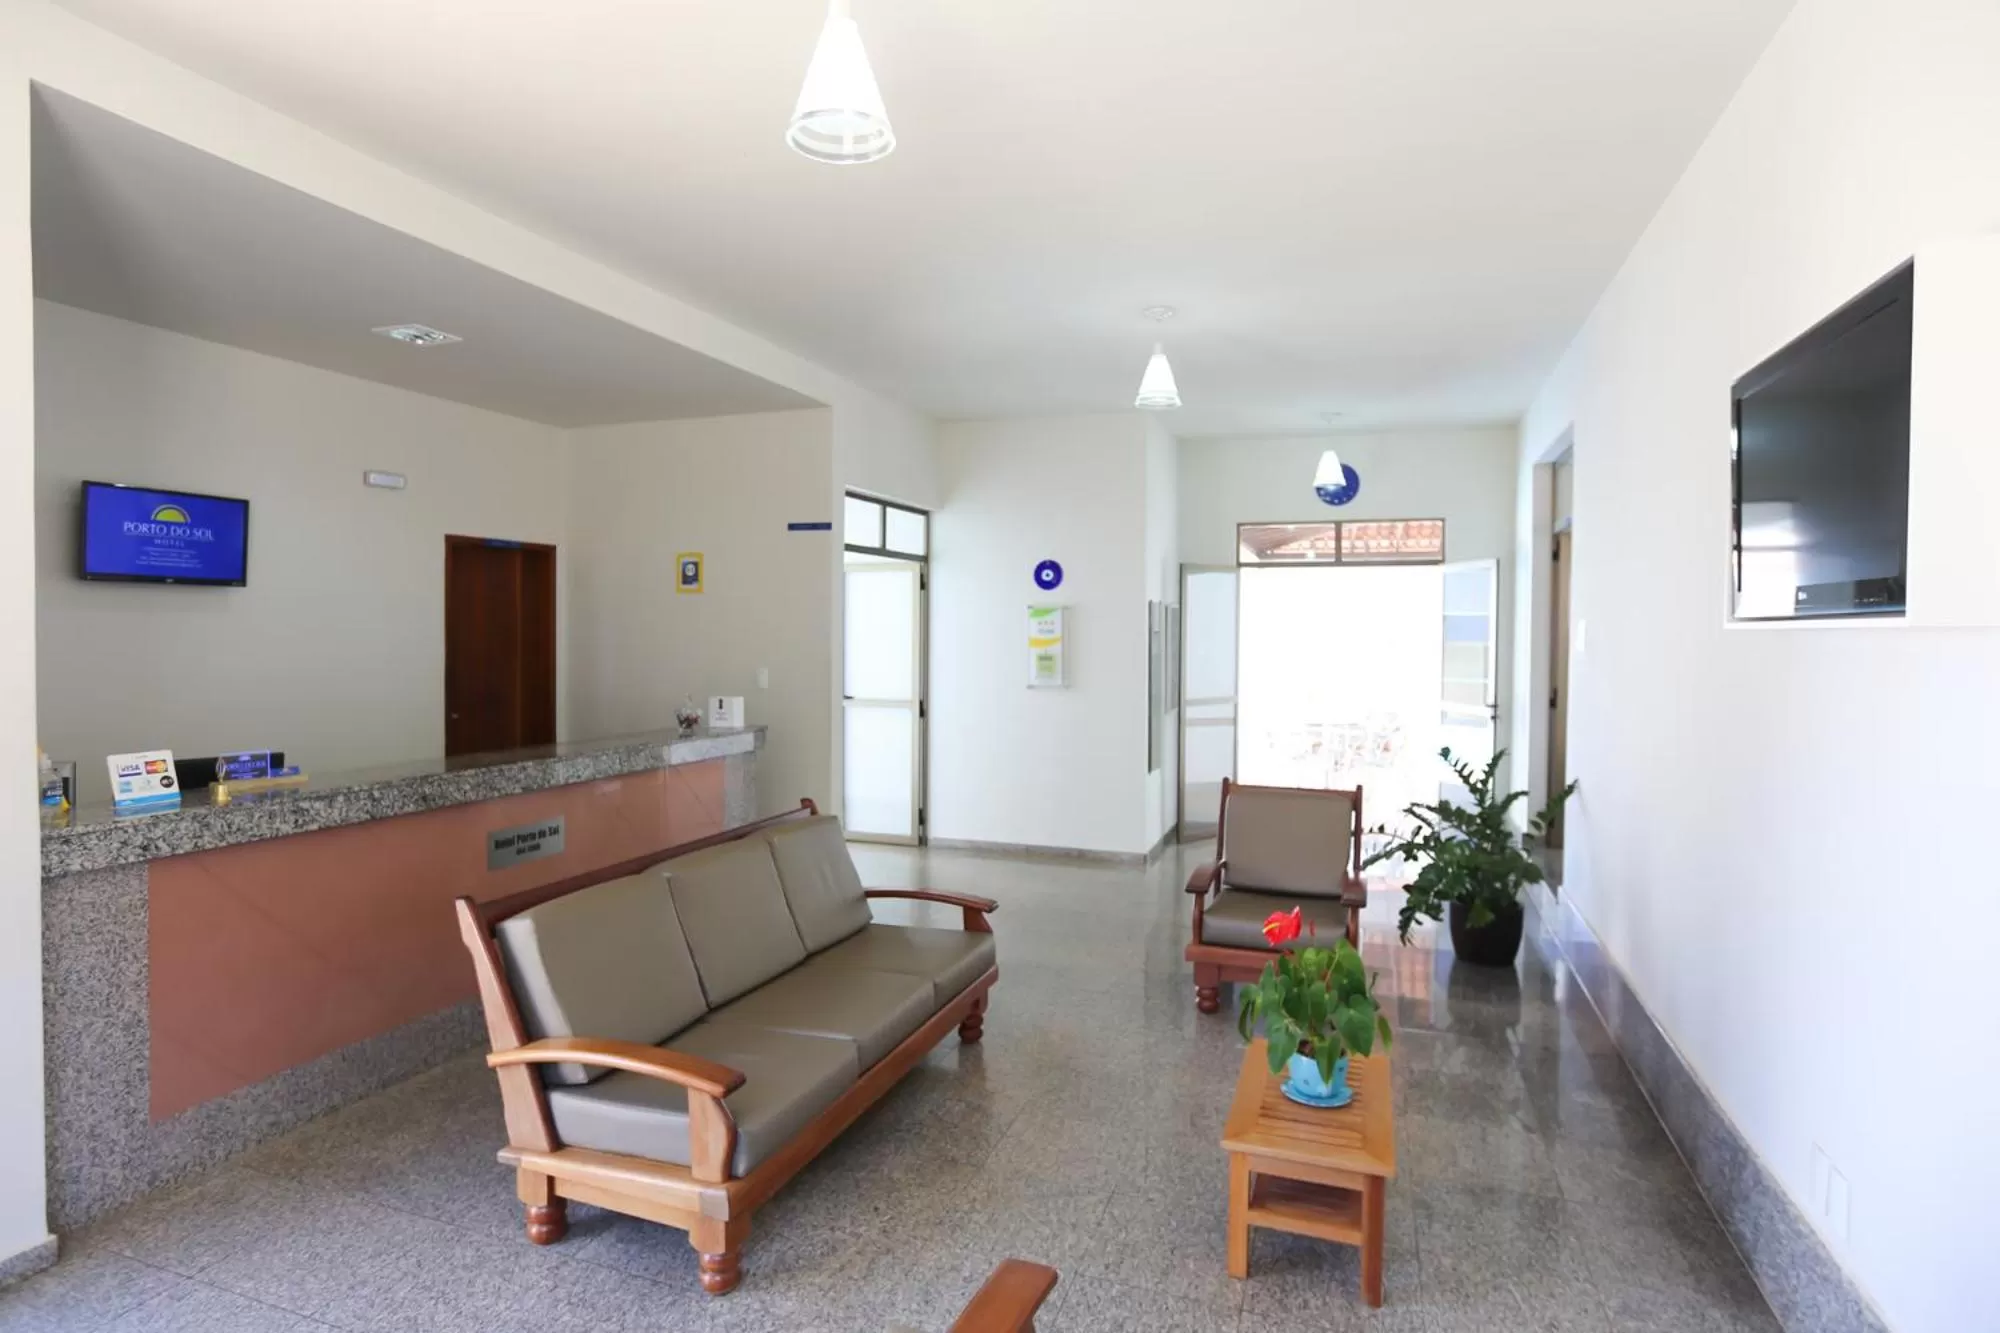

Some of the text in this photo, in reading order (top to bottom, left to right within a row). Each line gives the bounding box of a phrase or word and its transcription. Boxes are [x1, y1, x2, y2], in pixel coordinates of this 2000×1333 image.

[123, 521, 215, 541] PORTO DO SOL
[120, 763, 141, 772] VISA
